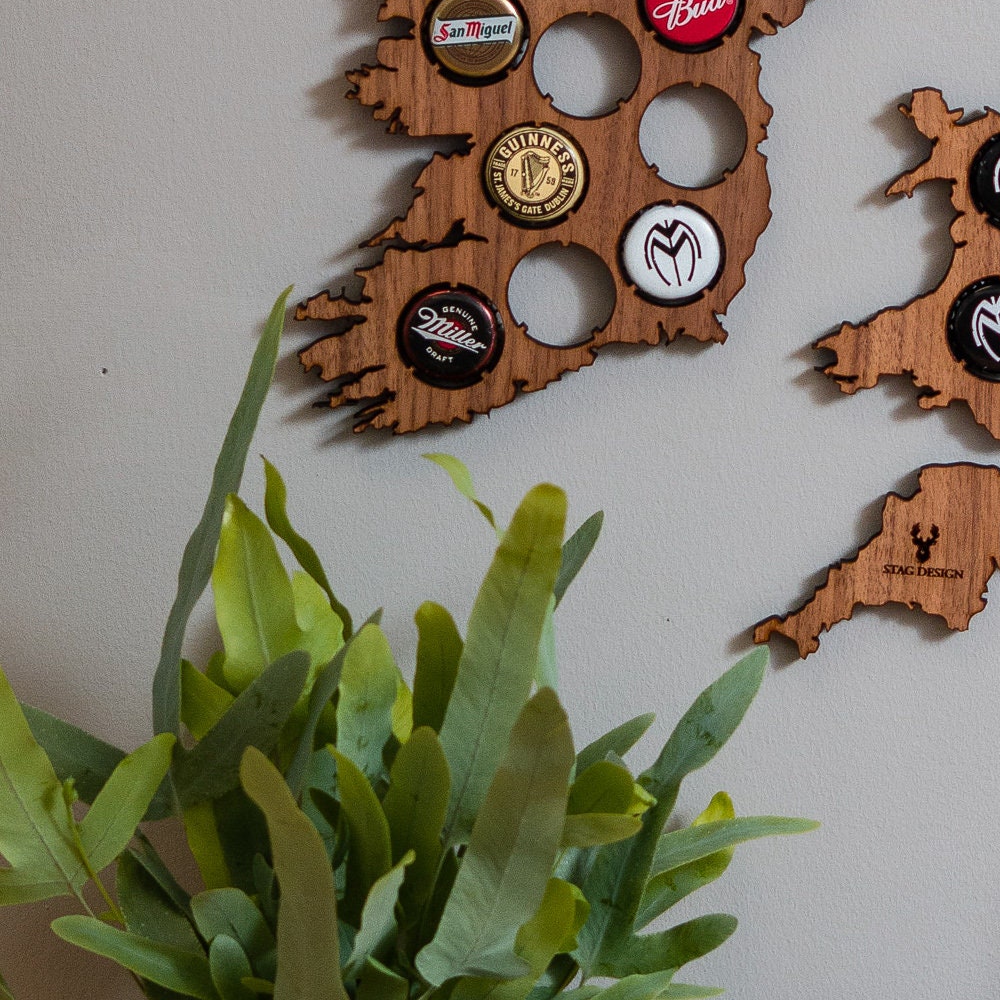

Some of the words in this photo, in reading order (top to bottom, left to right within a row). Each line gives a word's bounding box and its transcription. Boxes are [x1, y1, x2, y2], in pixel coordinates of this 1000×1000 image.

[433, 23, 465, 43] San
[465, 21, 513, 39] Miguel
[498, 133, 575, 173] GUINNESS
[521, 205, 543, 215] GATE
[544, 187, 570, 212] DUBLIN
[417, 307, 487, 349] Miller
[442, 306, 478, 332] GENUINE
[425, 346, 454, 363] DRAFT
[882, 563, 915, 577] STAG
[916, 565, 964, 580] DESIGN
